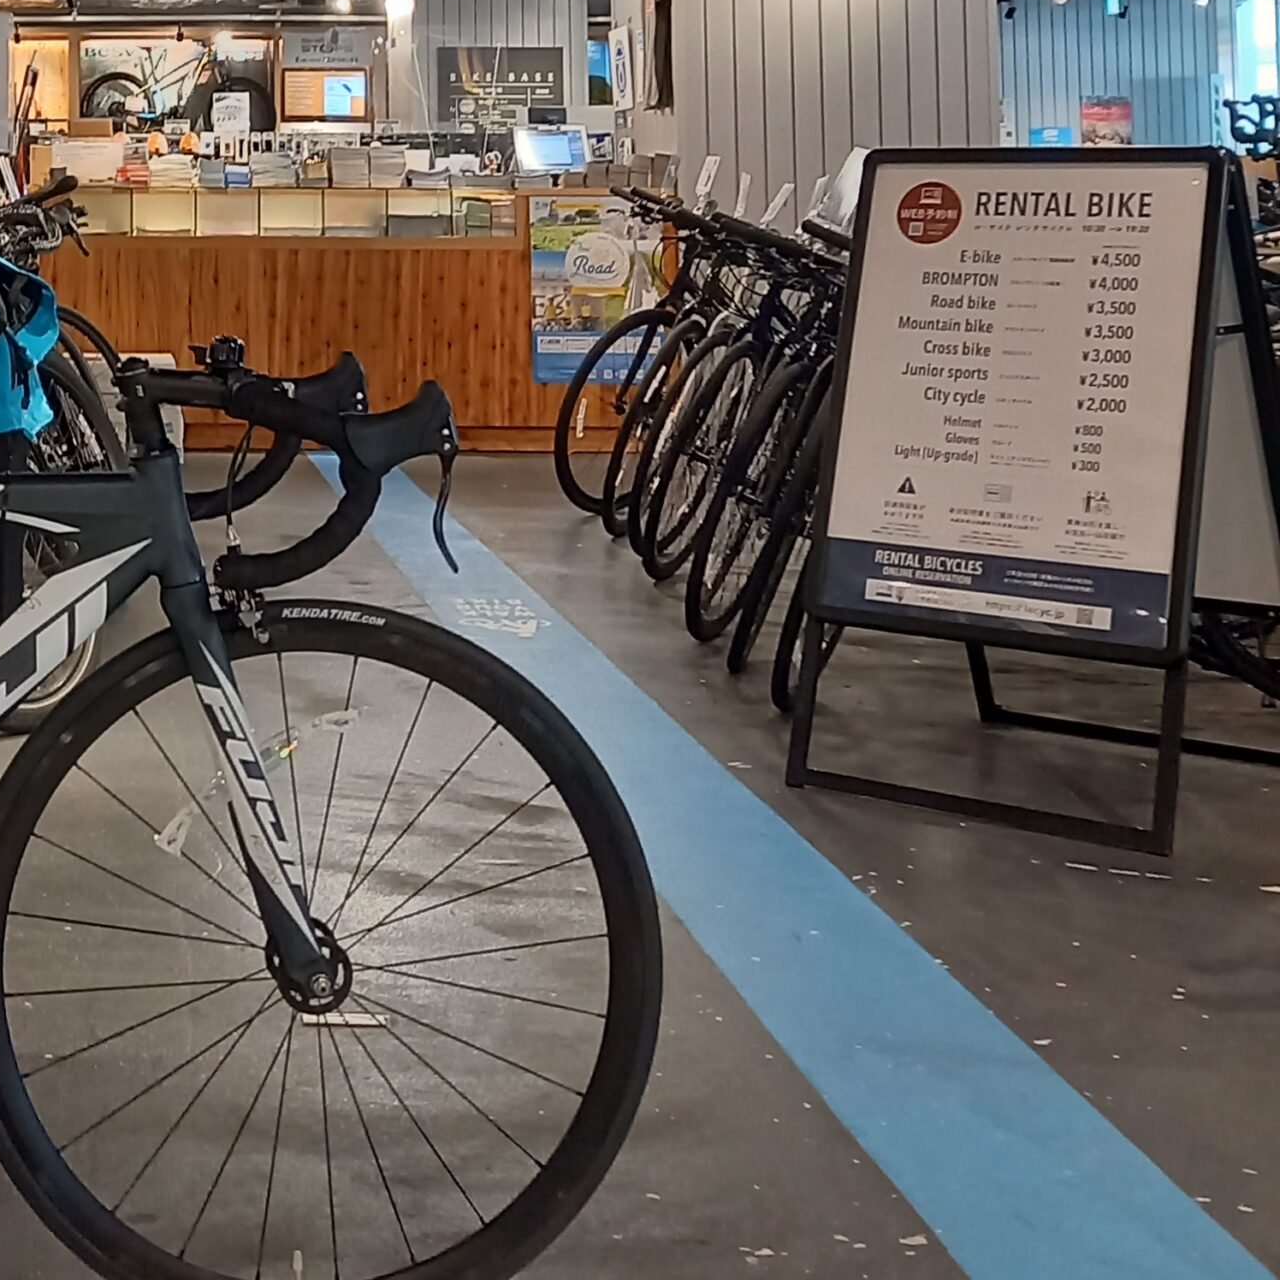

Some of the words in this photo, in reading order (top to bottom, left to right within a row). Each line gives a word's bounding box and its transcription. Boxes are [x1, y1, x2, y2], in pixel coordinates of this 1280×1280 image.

[508, 72, 555, 82] BASE
[974, 191, 1076, 218] RENTAL
[1087, 192, 1153, 218] BIKE
[573, 255, 616, 275] Road
[959, 250, 1002, 265] E-bike
[1091, 253, 1141, 269] ¥4,500
[921, 271, 1000, 288] BROMPTON
[1088, 276, 1139, 293] ¥4,000
[930, 294, 964, 310] Road
[968, 296, 996, 311] bike
[1086, 300, 1137, 317] ¥3,500
[898, 316, 961, 332] Mountain
[964, 318, 994, 334] bike
[1083, 324, 1135, 341] ¥3,500
[923, 339, 958, 356] Cross
[961, 341, 992, 358] bike
[1081, 349, 1132, 366] ¥3,000
[901, 362, 945, 379] Junior
[946, 367, 989, 384] sports
[1079, 373, 1130, 390] ¥2,500
[924, 386, 952, 404] City
[953, 388, 986, 406] cycle
[1076, 397, 1127, 414] ¥2,000
[943, 415, 982, 429] Helmet
[945, 432, 980, 446] Gloves
[894, 444, 921, 459] Light
[1071, 460, 1100, 473] ¥300
[874, 549, 921, 568] RENTAL
[923, 555, 984, 575] BICYCLES
